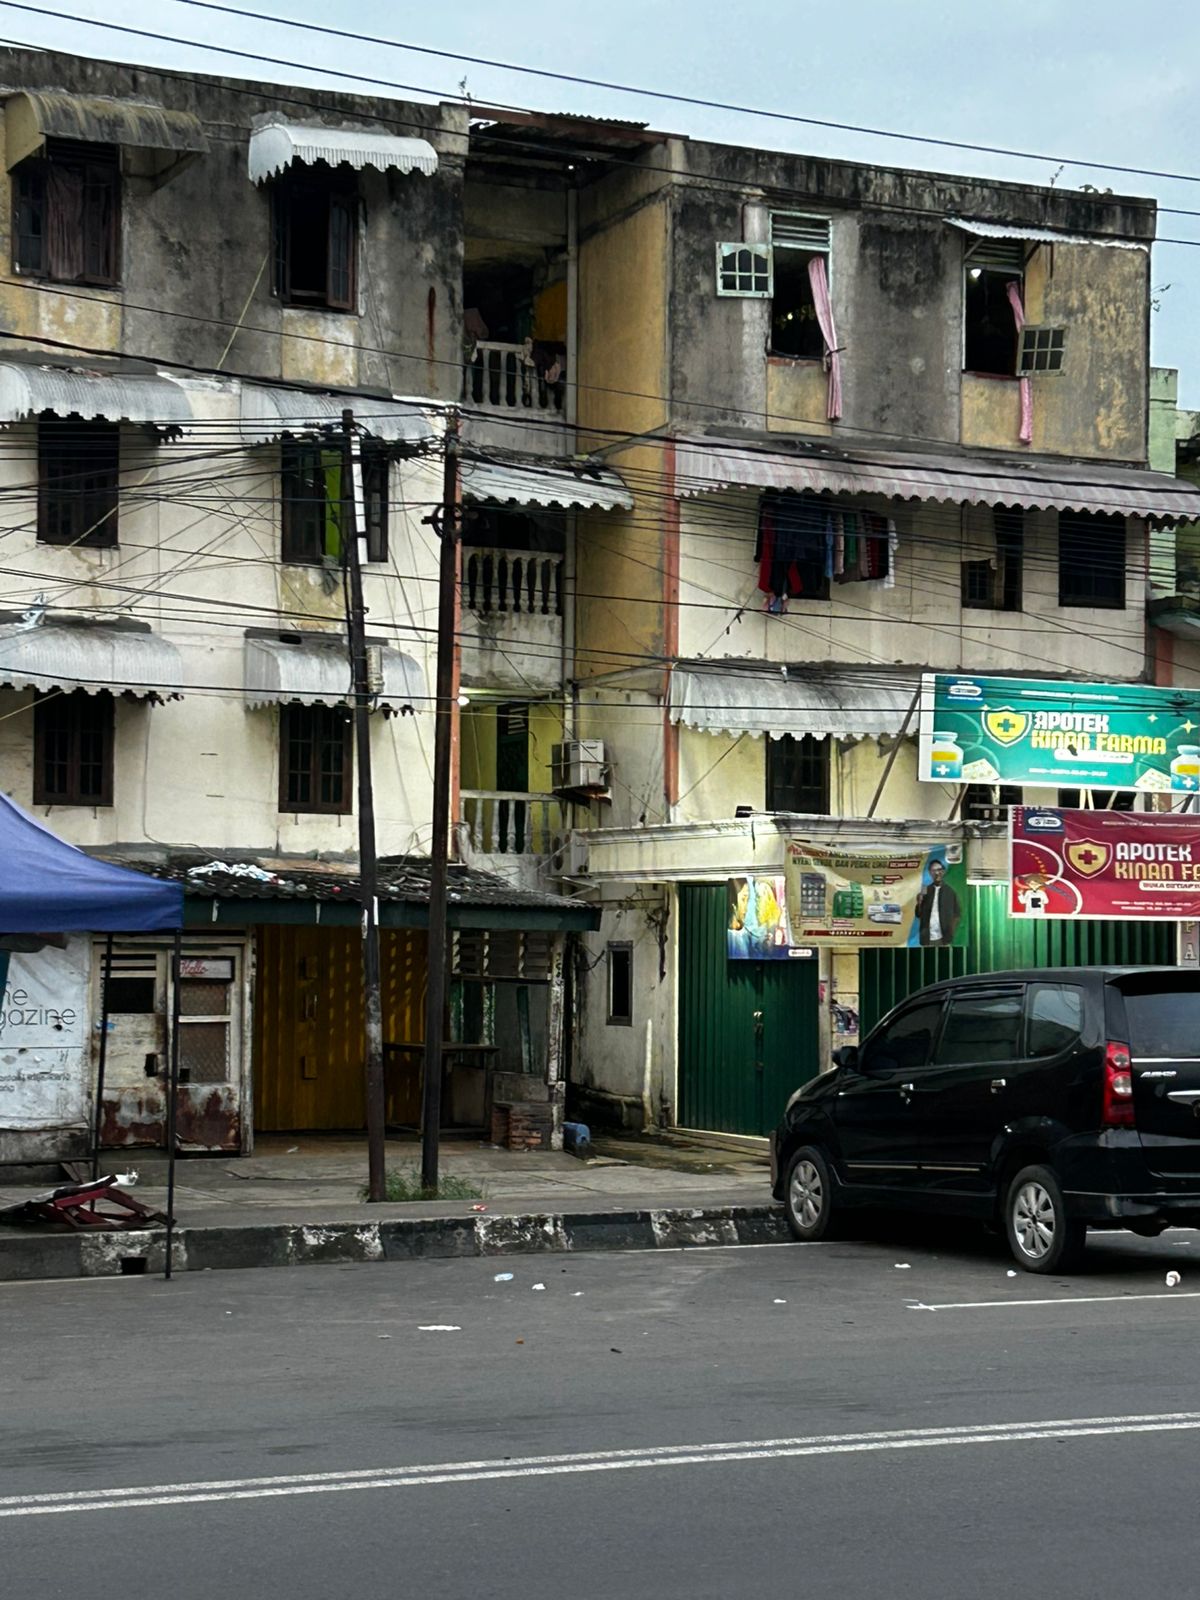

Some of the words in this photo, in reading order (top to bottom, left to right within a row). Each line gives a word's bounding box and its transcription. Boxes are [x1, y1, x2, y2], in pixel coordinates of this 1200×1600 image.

[1034, 711, 1110, 733] APOTEK
[1095, 734, 1167, 755] FARMA
[1116, 842, 1192, 861] APOTEK
[1115, 861, 1174, 880] KINAN
